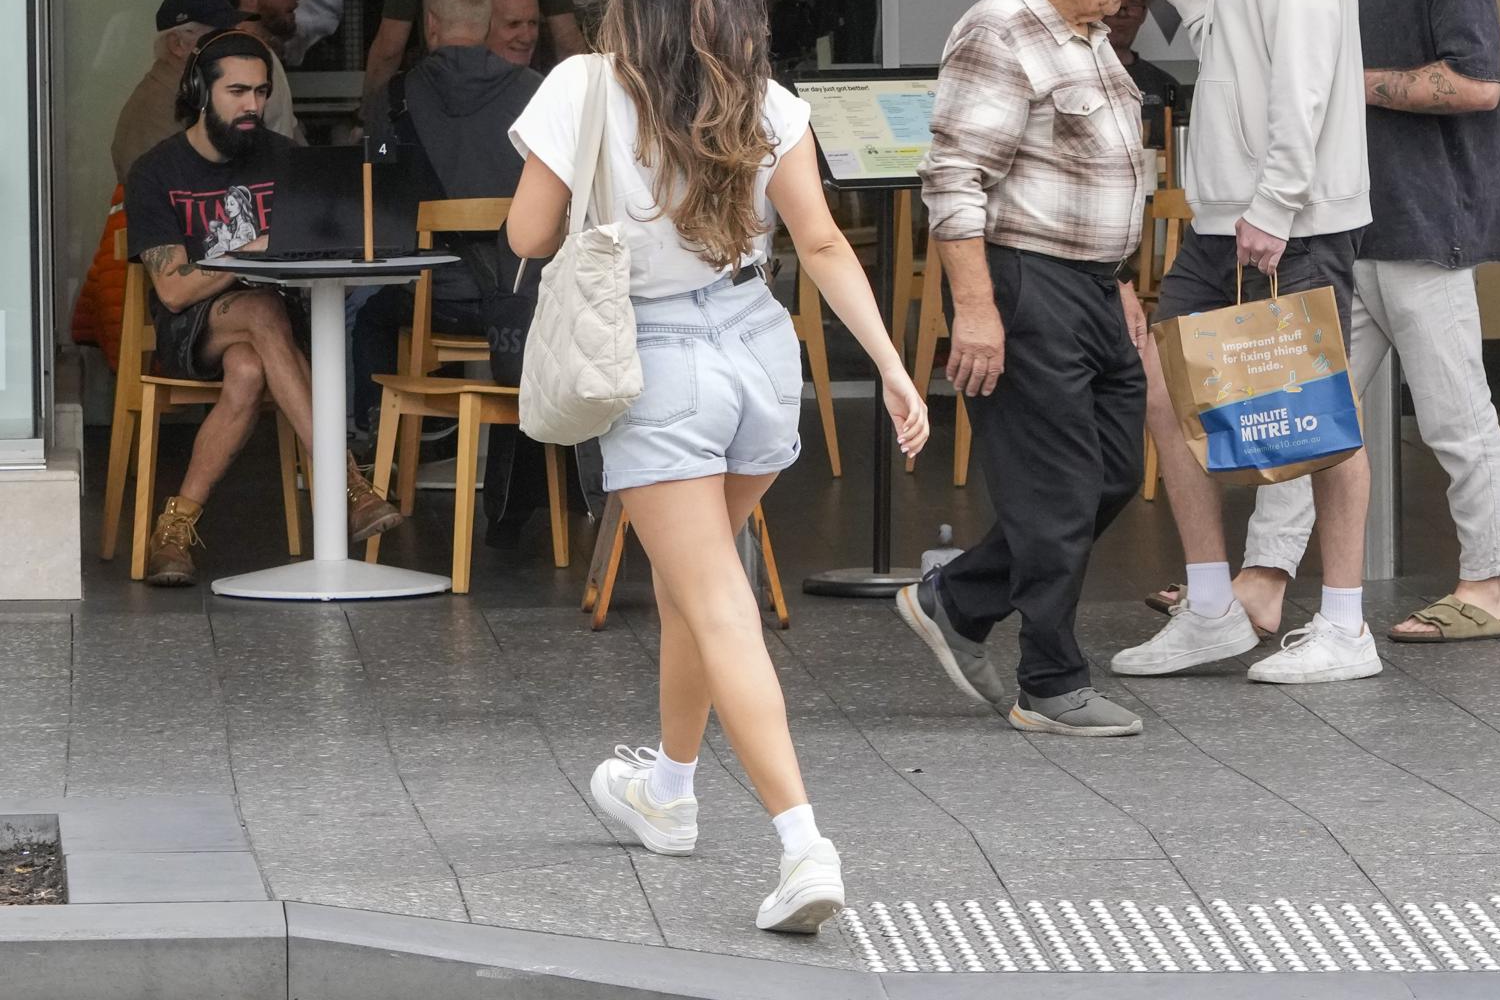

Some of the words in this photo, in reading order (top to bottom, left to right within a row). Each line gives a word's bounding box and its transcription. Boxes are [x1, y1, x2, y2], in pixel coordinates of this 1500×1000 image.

[823, 85, 835, 94] just
[379, 143, 388, 156] 4
[1221, 335, 1276, 352] Important
[1278, 329, 1303, 343] stuff
[1223, 354, 1237, 365] for
[1240, 351, 1271, 365] fixing
[1274, 344, 1309, 356] things
[1247, 362, 1284, 375] inside.
[1240, 407, 1288, 426] SUNLITE
[1241, 420, 1291, 442] MITRE
[1294, 415, 1318, 434] 10
